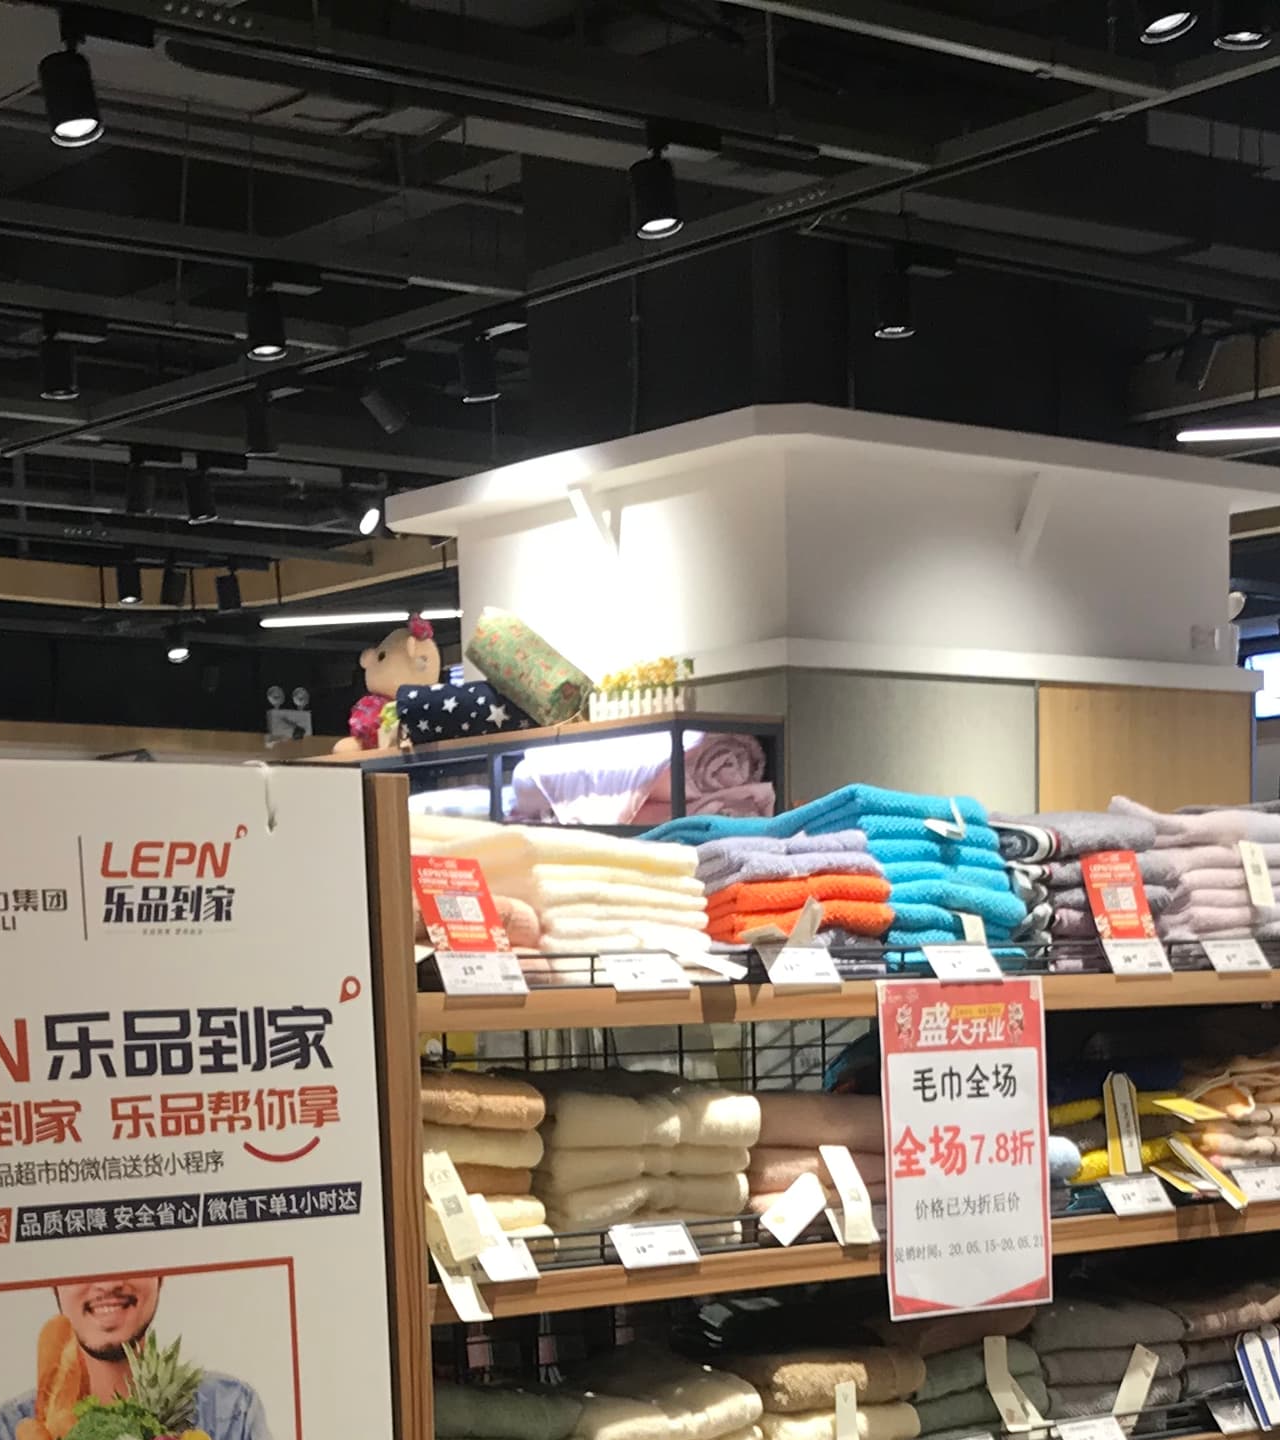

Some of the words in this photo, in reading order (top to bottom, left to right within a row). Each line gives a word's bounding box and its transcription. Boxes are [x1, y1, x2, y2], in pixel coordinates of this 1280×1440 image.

[100, 841, 231, 880] LEPN
[103, 885, 236, 925] 乐品到家
[44, 1005, 333, 1082] 乐品到家
[917, 1002, 1006, 1047] 盛大开业
[913, 1063, 1017, 1102] 毛巾全场
[110, 1085, 341, 1140] 乐品帮你拿
[894, 1125, 1035, 1178] 全场7.8折
[20, 1204, 109, 1238] 品质保障
[114, 1199, 198, 1231] 安全省心
[207, 1187, 359, 1222] 微信下单1小时达
[915, 1192, 1020, 1221] 价格已为折后价
